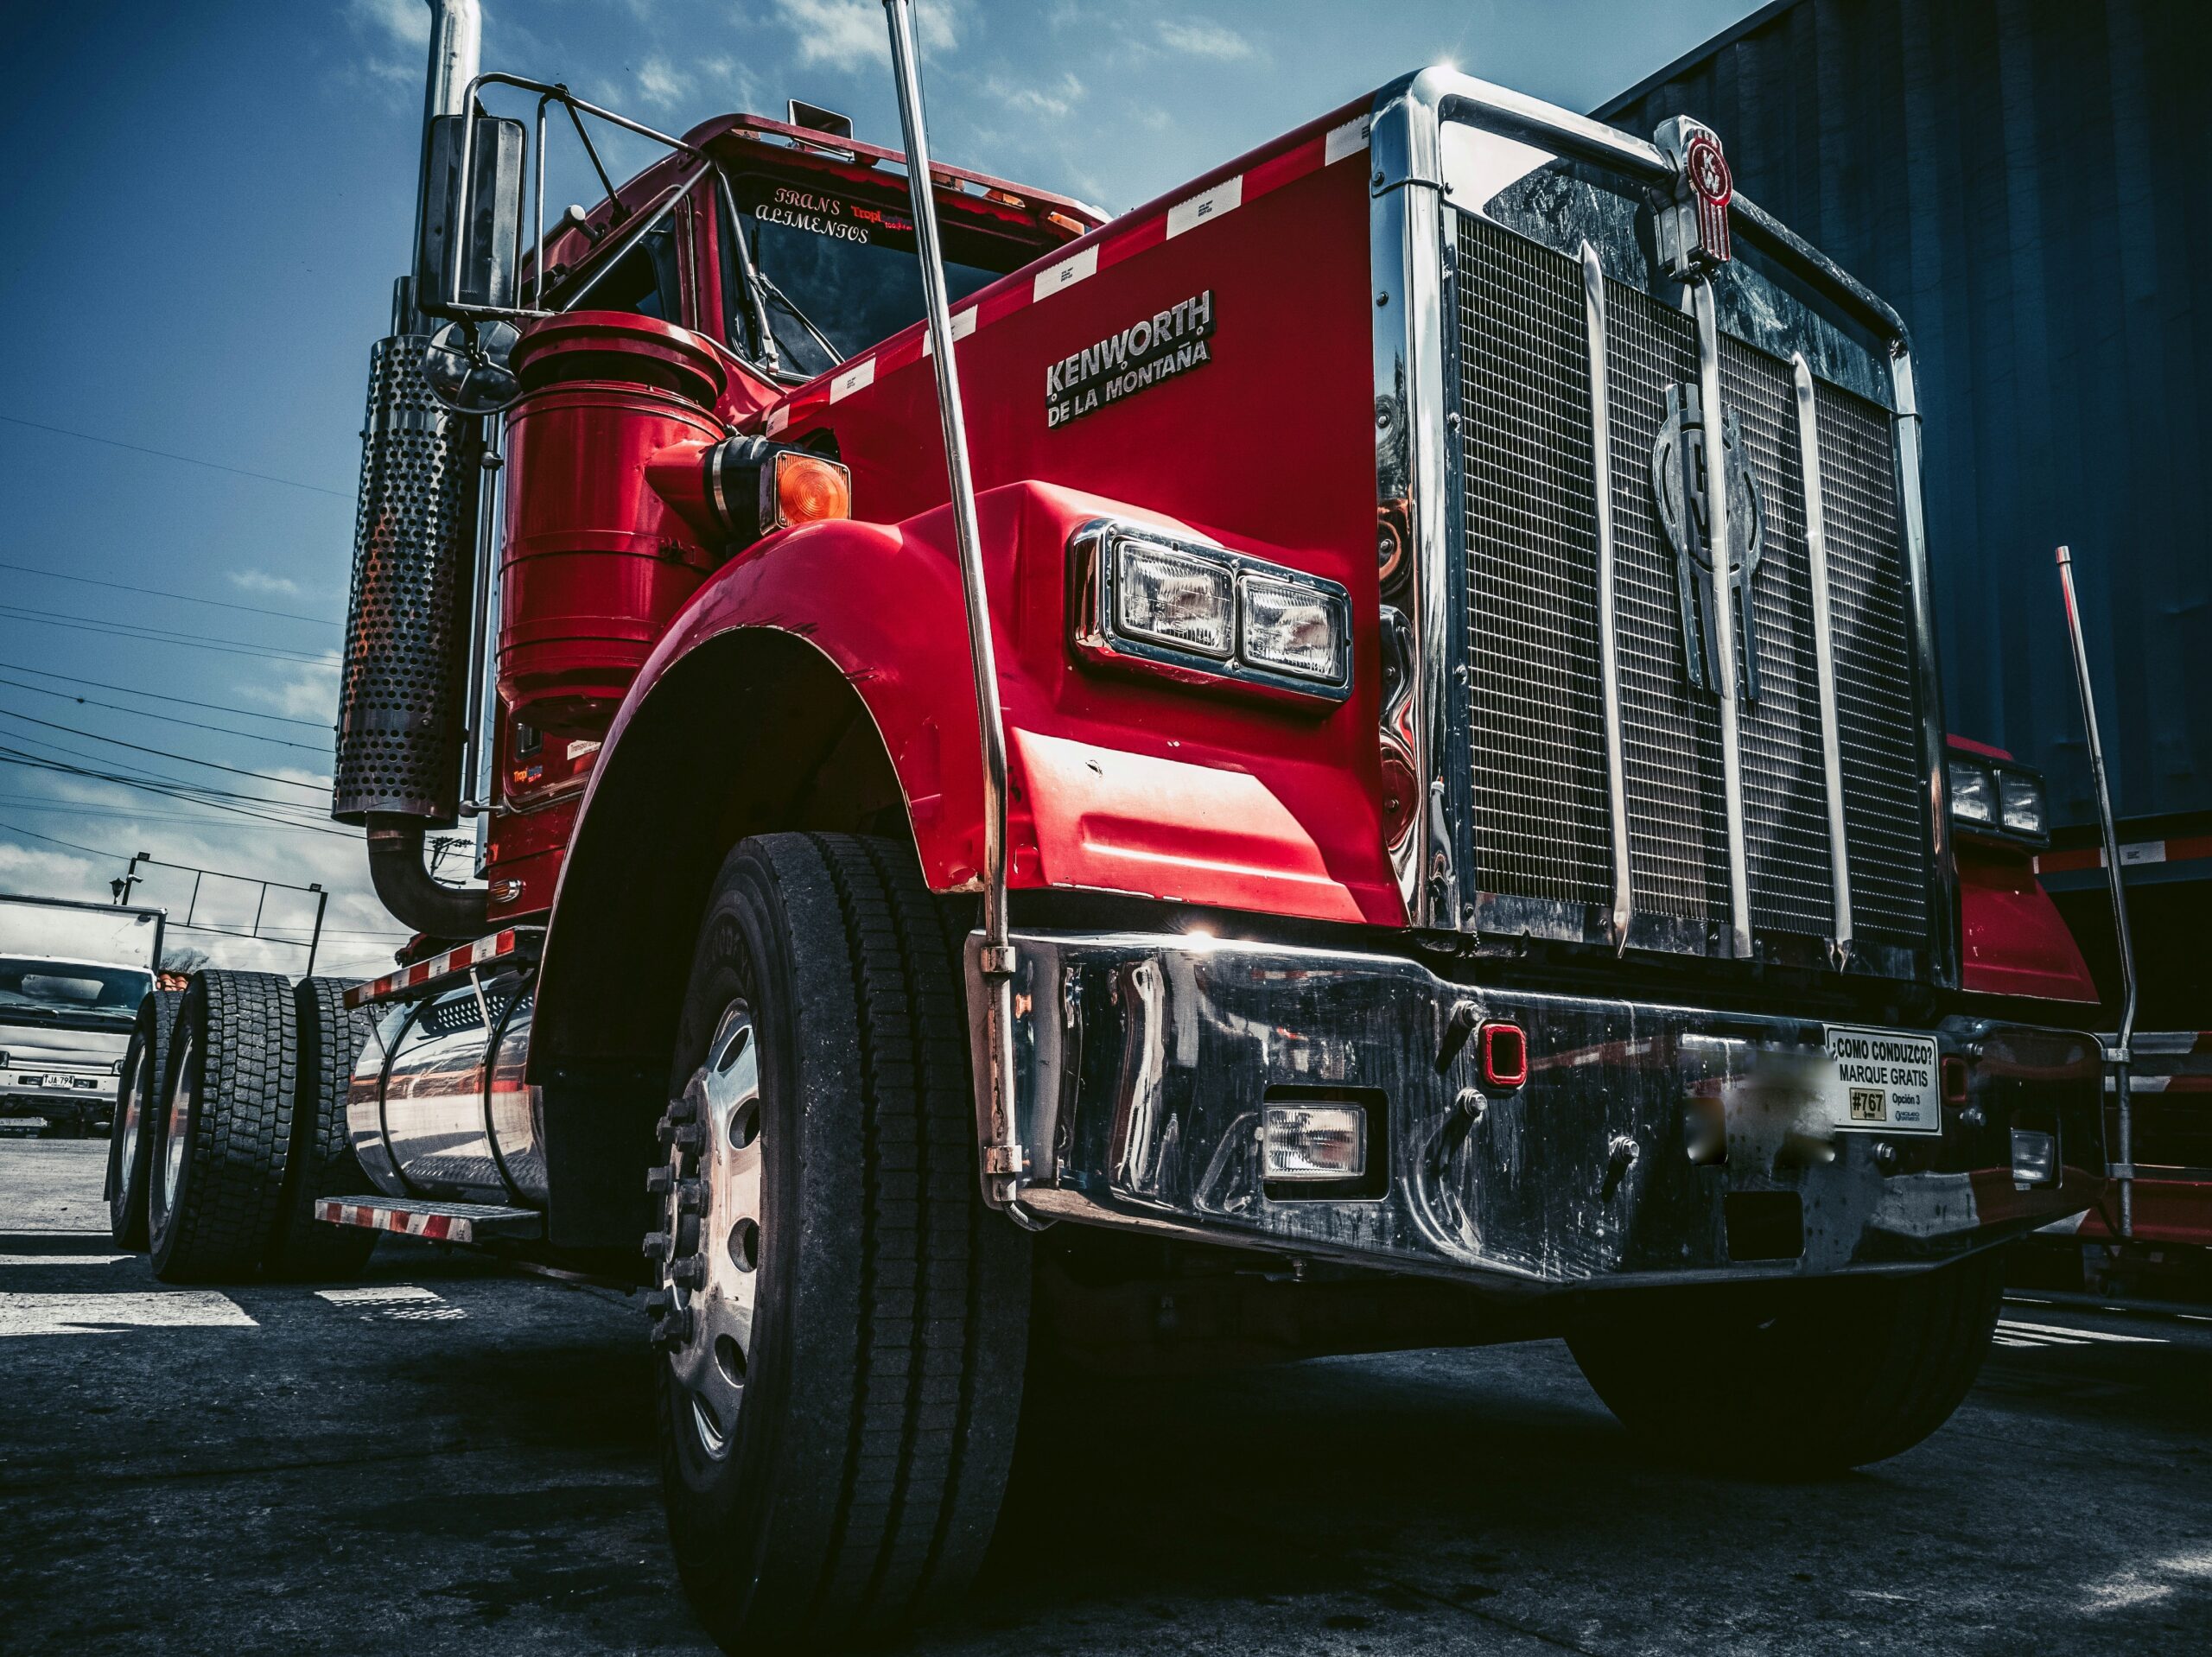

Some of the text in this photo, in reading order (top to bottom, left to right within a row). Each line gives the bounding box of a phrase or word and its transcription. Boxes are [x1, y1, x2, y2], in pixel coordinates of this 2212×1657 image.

[774, 187, 841, 216] TRANS
[755, 204, 869, 244] ALIMENTOS
[1046, 289, 1210, 397] KENWORTH
[1048, 340, 1209, 428] DE LA MONTAÑA
[1872, 1040, 1933, 1065] CONDUZCO?
[1839, 1063, 1929, 1088] MARQUE GRATIS
[1853, 1092, 1884, 1112] #767
[1892, 1093, 1920, 1106] Opción 3
